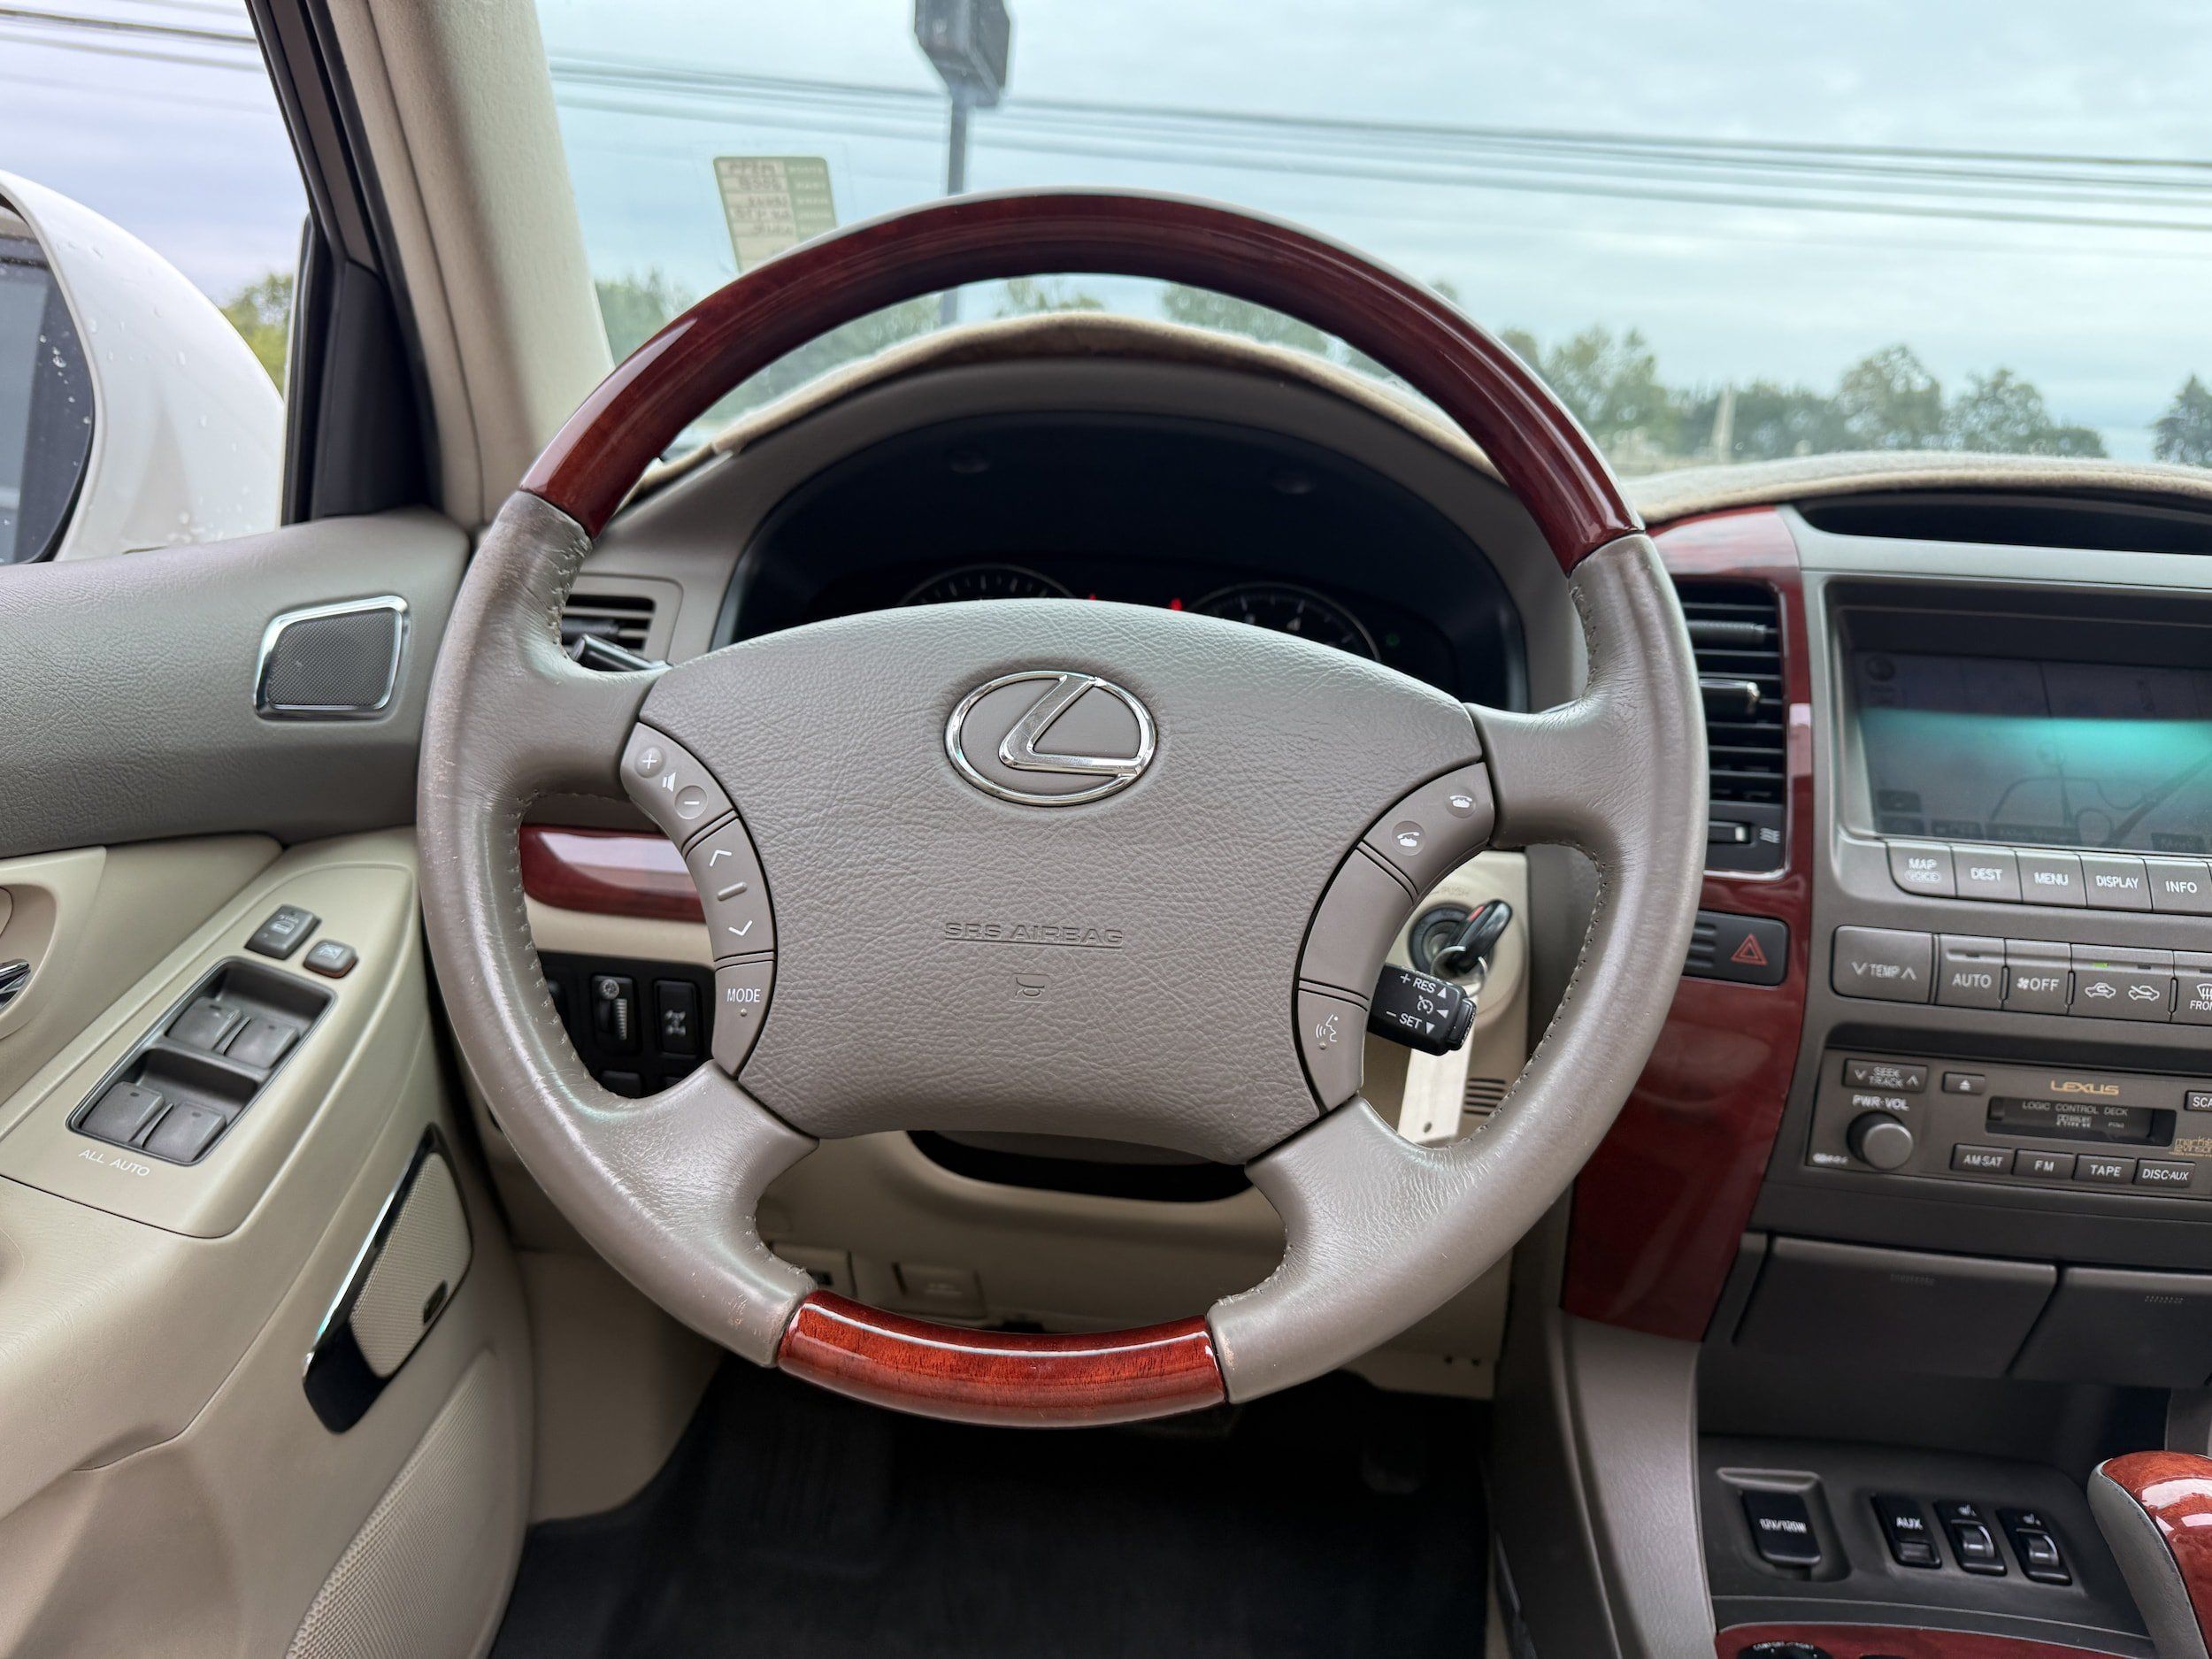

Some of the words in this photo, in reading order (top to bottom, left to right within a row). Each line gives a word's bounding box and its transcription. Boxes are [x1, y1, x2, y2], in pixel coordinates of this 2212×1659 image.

[1909, 857, 1938, 871] MAP
[1970, 867, 2003, 881] DEST
[2034, 872, 2069, 887] MENU
[2095, 874, 2139, 890] DISPLAY
[2165, 880, 2198, 894] INFO
[944, 923, 1002, 939] SRS
[1010, 925, 1123, 946] AIRBAG
[1870, 964, 1901, 978] TEMP
[1413, 977, 1437, 994] RES
[1952, 973, 1992, 989] AUTO
[2030, 977, 2060, 992] OFF
[726, 987, 761, 1002] MODE
[1399, 1012, 1423, 1029] SET
[1873, 1067, 1901, 1078] SEEK
[1868, 1075, 1904, 1089] TRACK
[2050, 1079, 2120, 1096] LEXUS
[2023, 1101, 2051, 1111] LOGIC
[2055, 1102, 2099, 1115] CONTROL
[2104, 1106, 2129, 1117] DECK
[78, 1149, 104, 1164] ALL
[109, 1158, 150, 1177] AUTO
[2034, 1159, 2055, 1172] FM
[2090, 1164, 2123, 1177] TAPE
[1896, 1517, 1924, 1530] AUX
